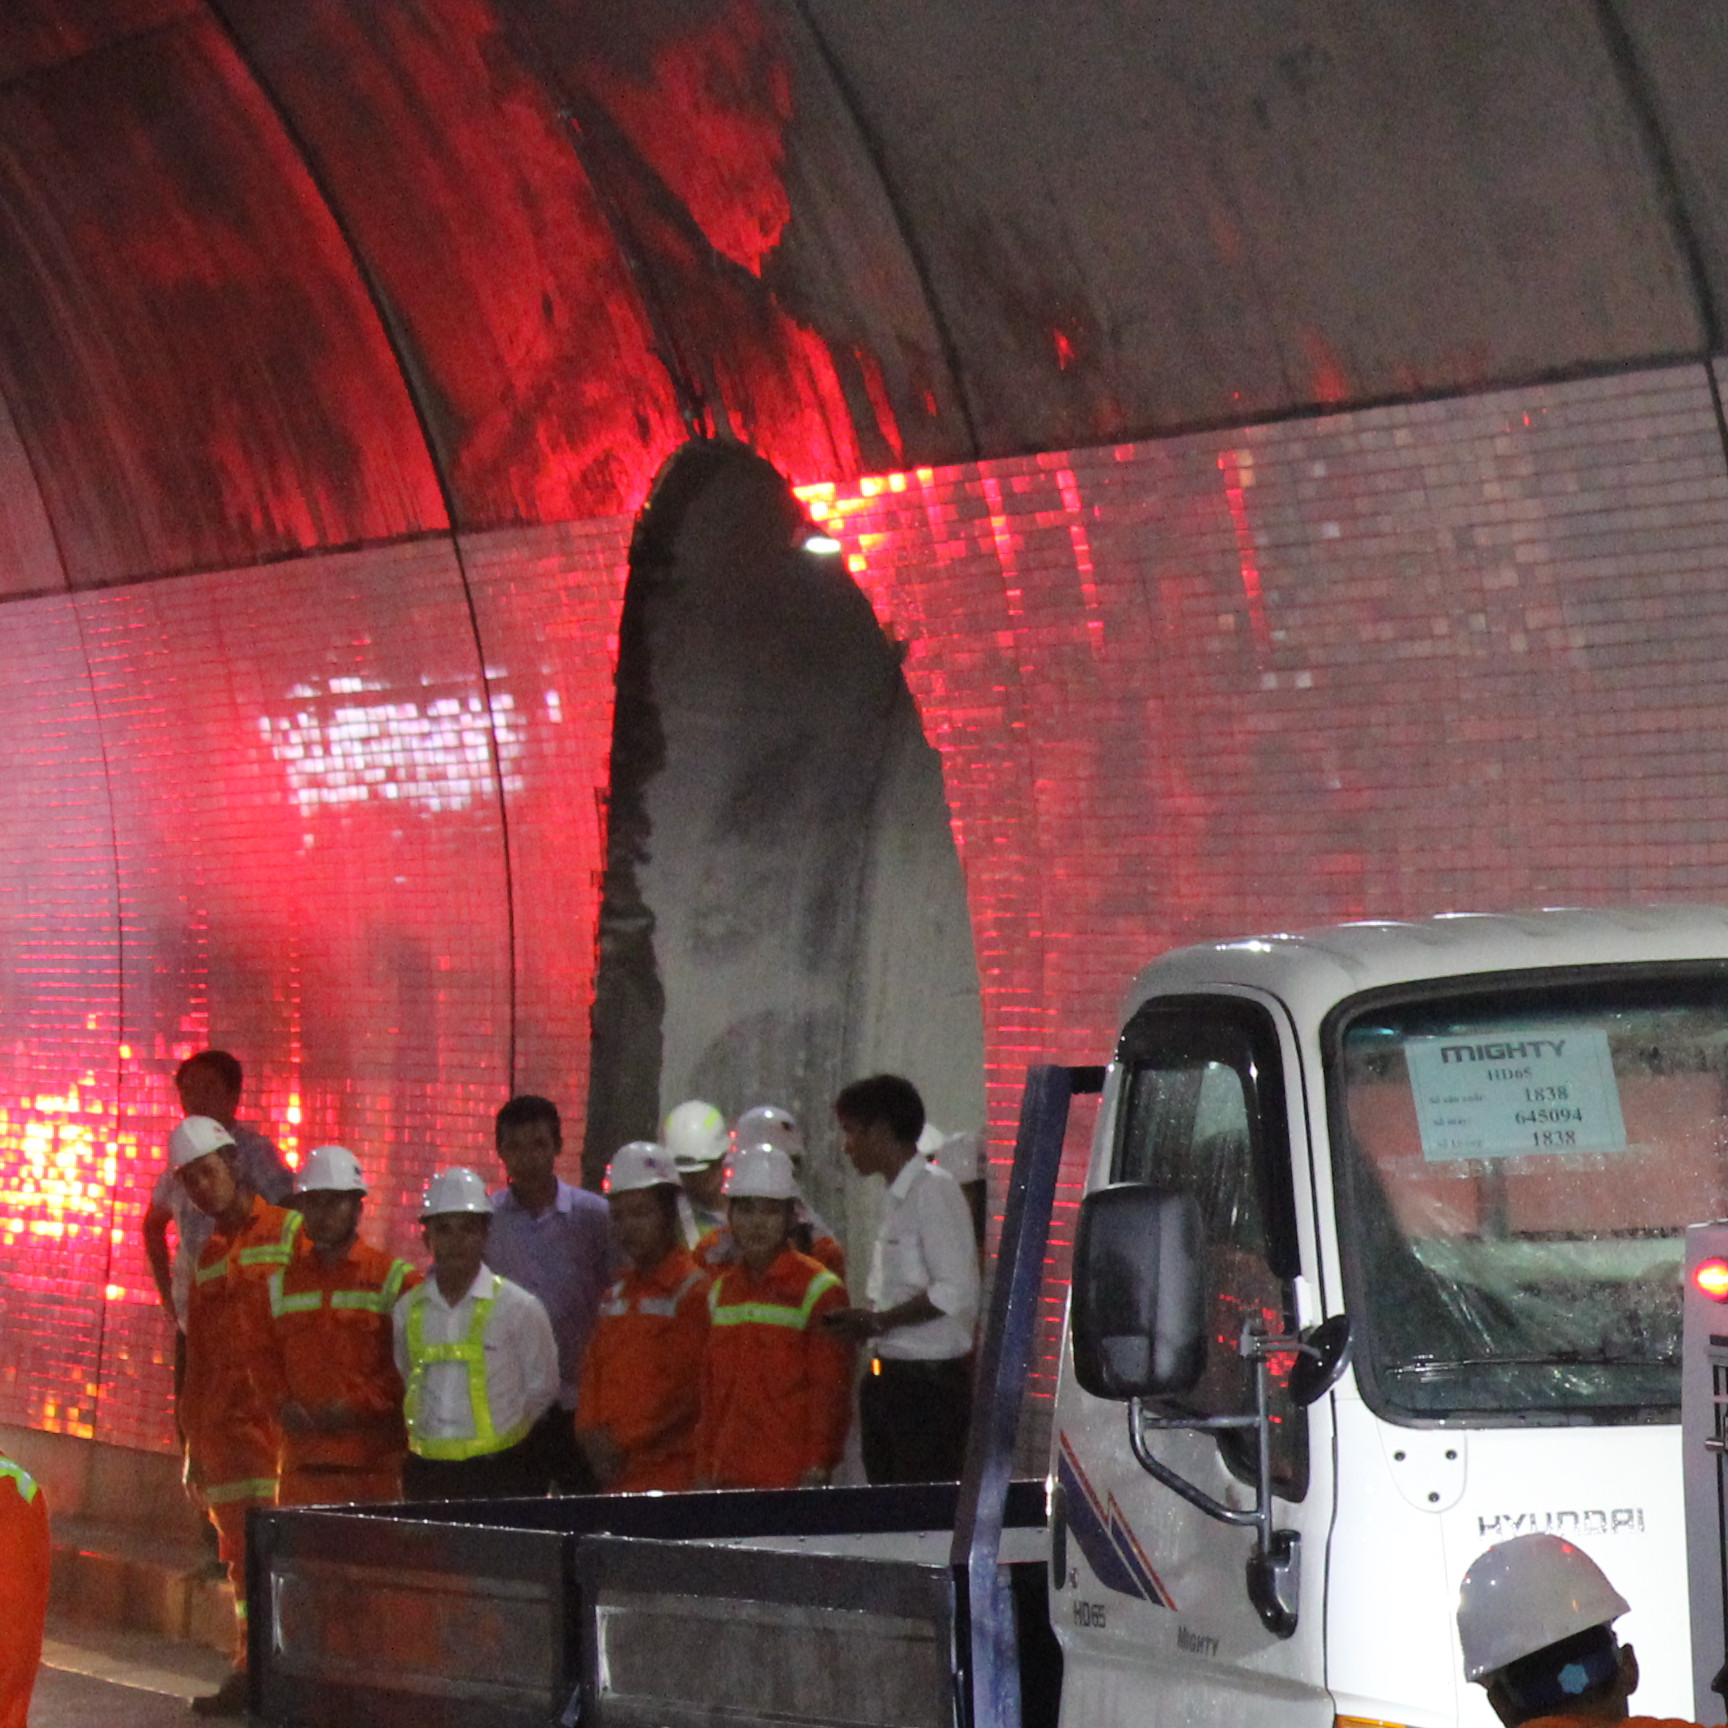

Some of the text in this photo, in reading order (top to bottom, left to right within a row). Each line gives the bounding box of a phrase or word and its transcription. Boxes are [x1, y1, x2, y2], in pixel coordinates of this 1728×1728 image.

[1440, 1039, 1567, 1064] MIGHTY
[1487, 1067, 1533, 1081] HD65
[1525, 1086, 1569, 1102] 1838
[1515, 1107, 1583, 1125] 645094
[1533, 1130, 1577, 1147] 1838
[1477, 1507, 1646, 1537] HYUNDAI
[1073, 1601, 1106, 1628] HD65
[1176, 1624, 1220, 1656] MIGHTY
